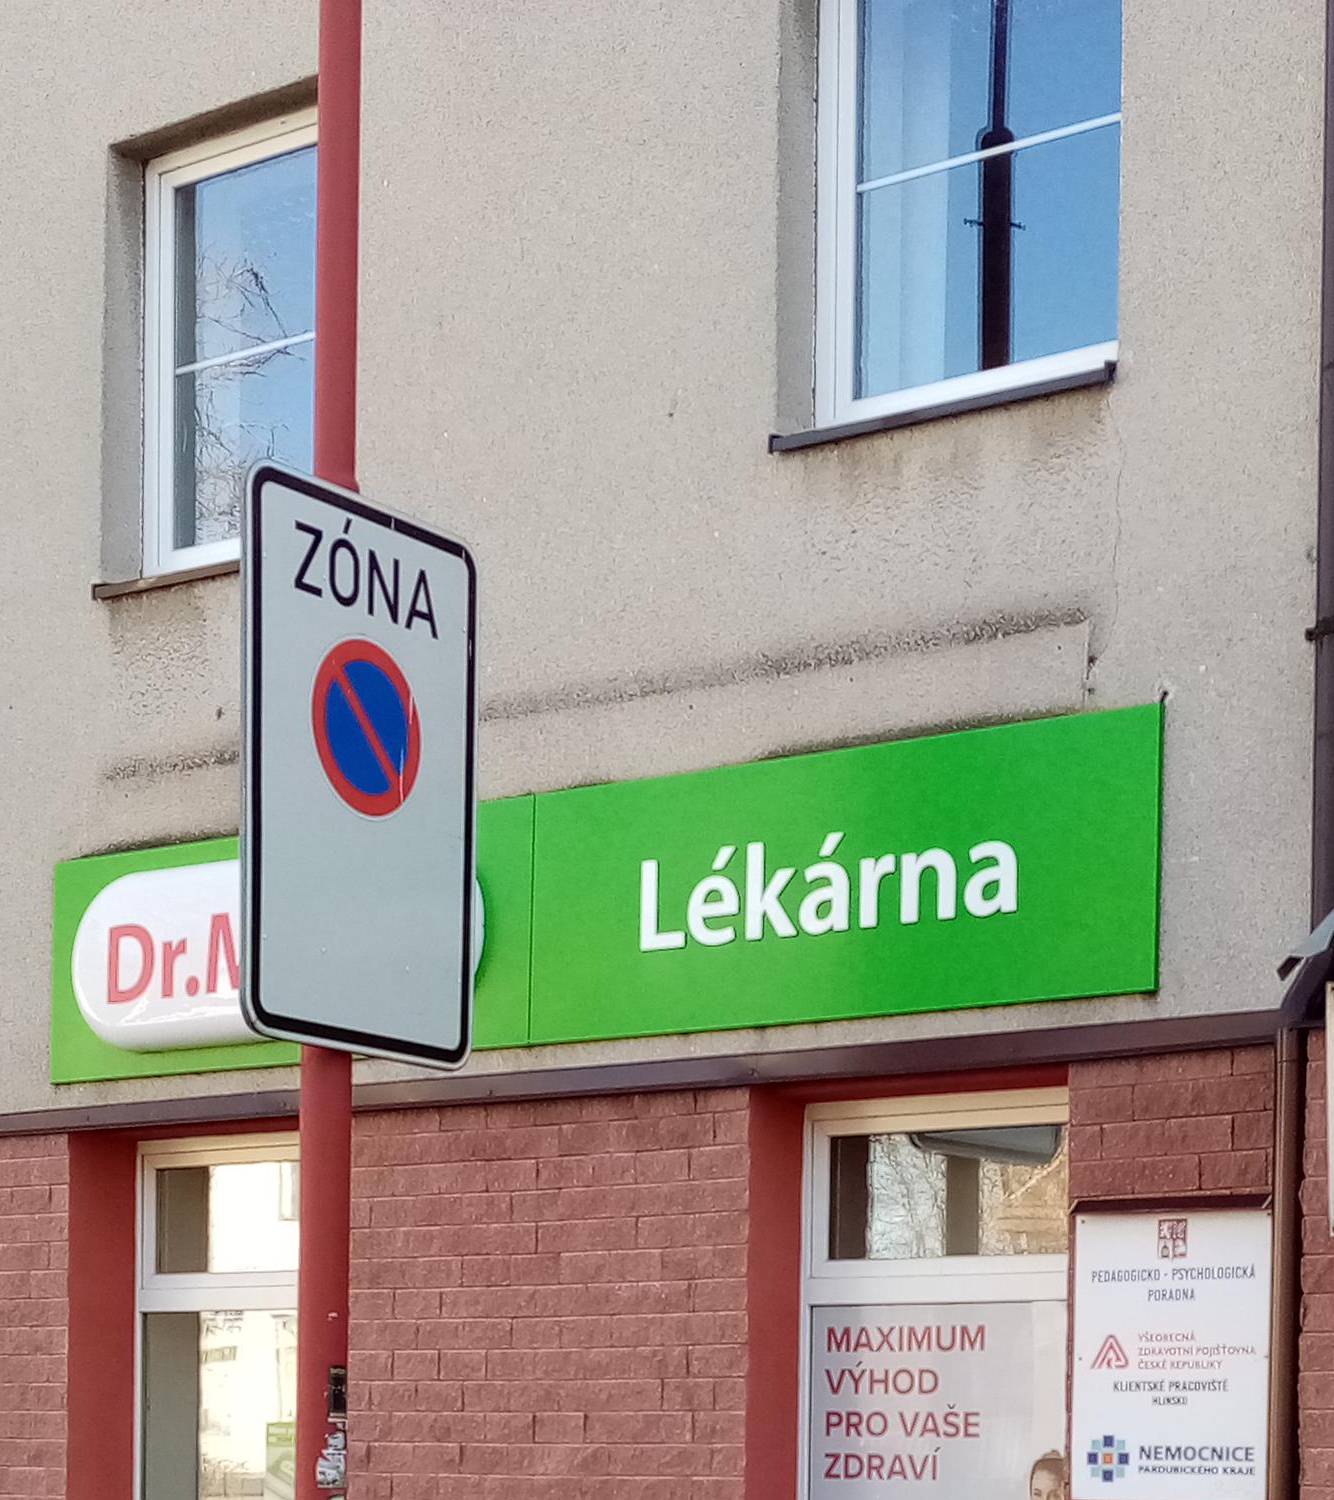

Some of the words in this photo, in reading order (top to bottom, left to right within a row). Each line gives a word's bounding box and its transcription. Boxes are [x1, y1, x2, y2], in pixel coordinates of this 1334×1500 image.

[294, 516, 439, 640] ZÓNA
[638, 830, 1019, 953] Lékárna
[106, 912, 241, 1006] Dr.M
[1091, 1268, 1161, 1283] PEDAGOGICKO
[1171, 1263, 1257, 1281] PSYCHOLOGICKÁ
[1147, 1288, 1196, 1302] PORADNA
[825, 1324, 987, 1353] MAXIMUM
[824, 1360, 940, 1396] VÝHOD
[1170, 1360, 1224, 1370] REPUBLIKY
[1113, 1378, 1166, 1393] KLIENTSKÉ
[824, 1410, 889, 1438] PRO
[898, 1402, 981, 1439] VAŠE
[823, 1446, 942, 1481] ZDRAVÍ
[1138, 1445, 1256, 1463] NEMOCNICE
[1137, 1464, 1219, 1476] PARDUBICKÉHO
[1221, 1465, 1256, 1476] KRAJE
